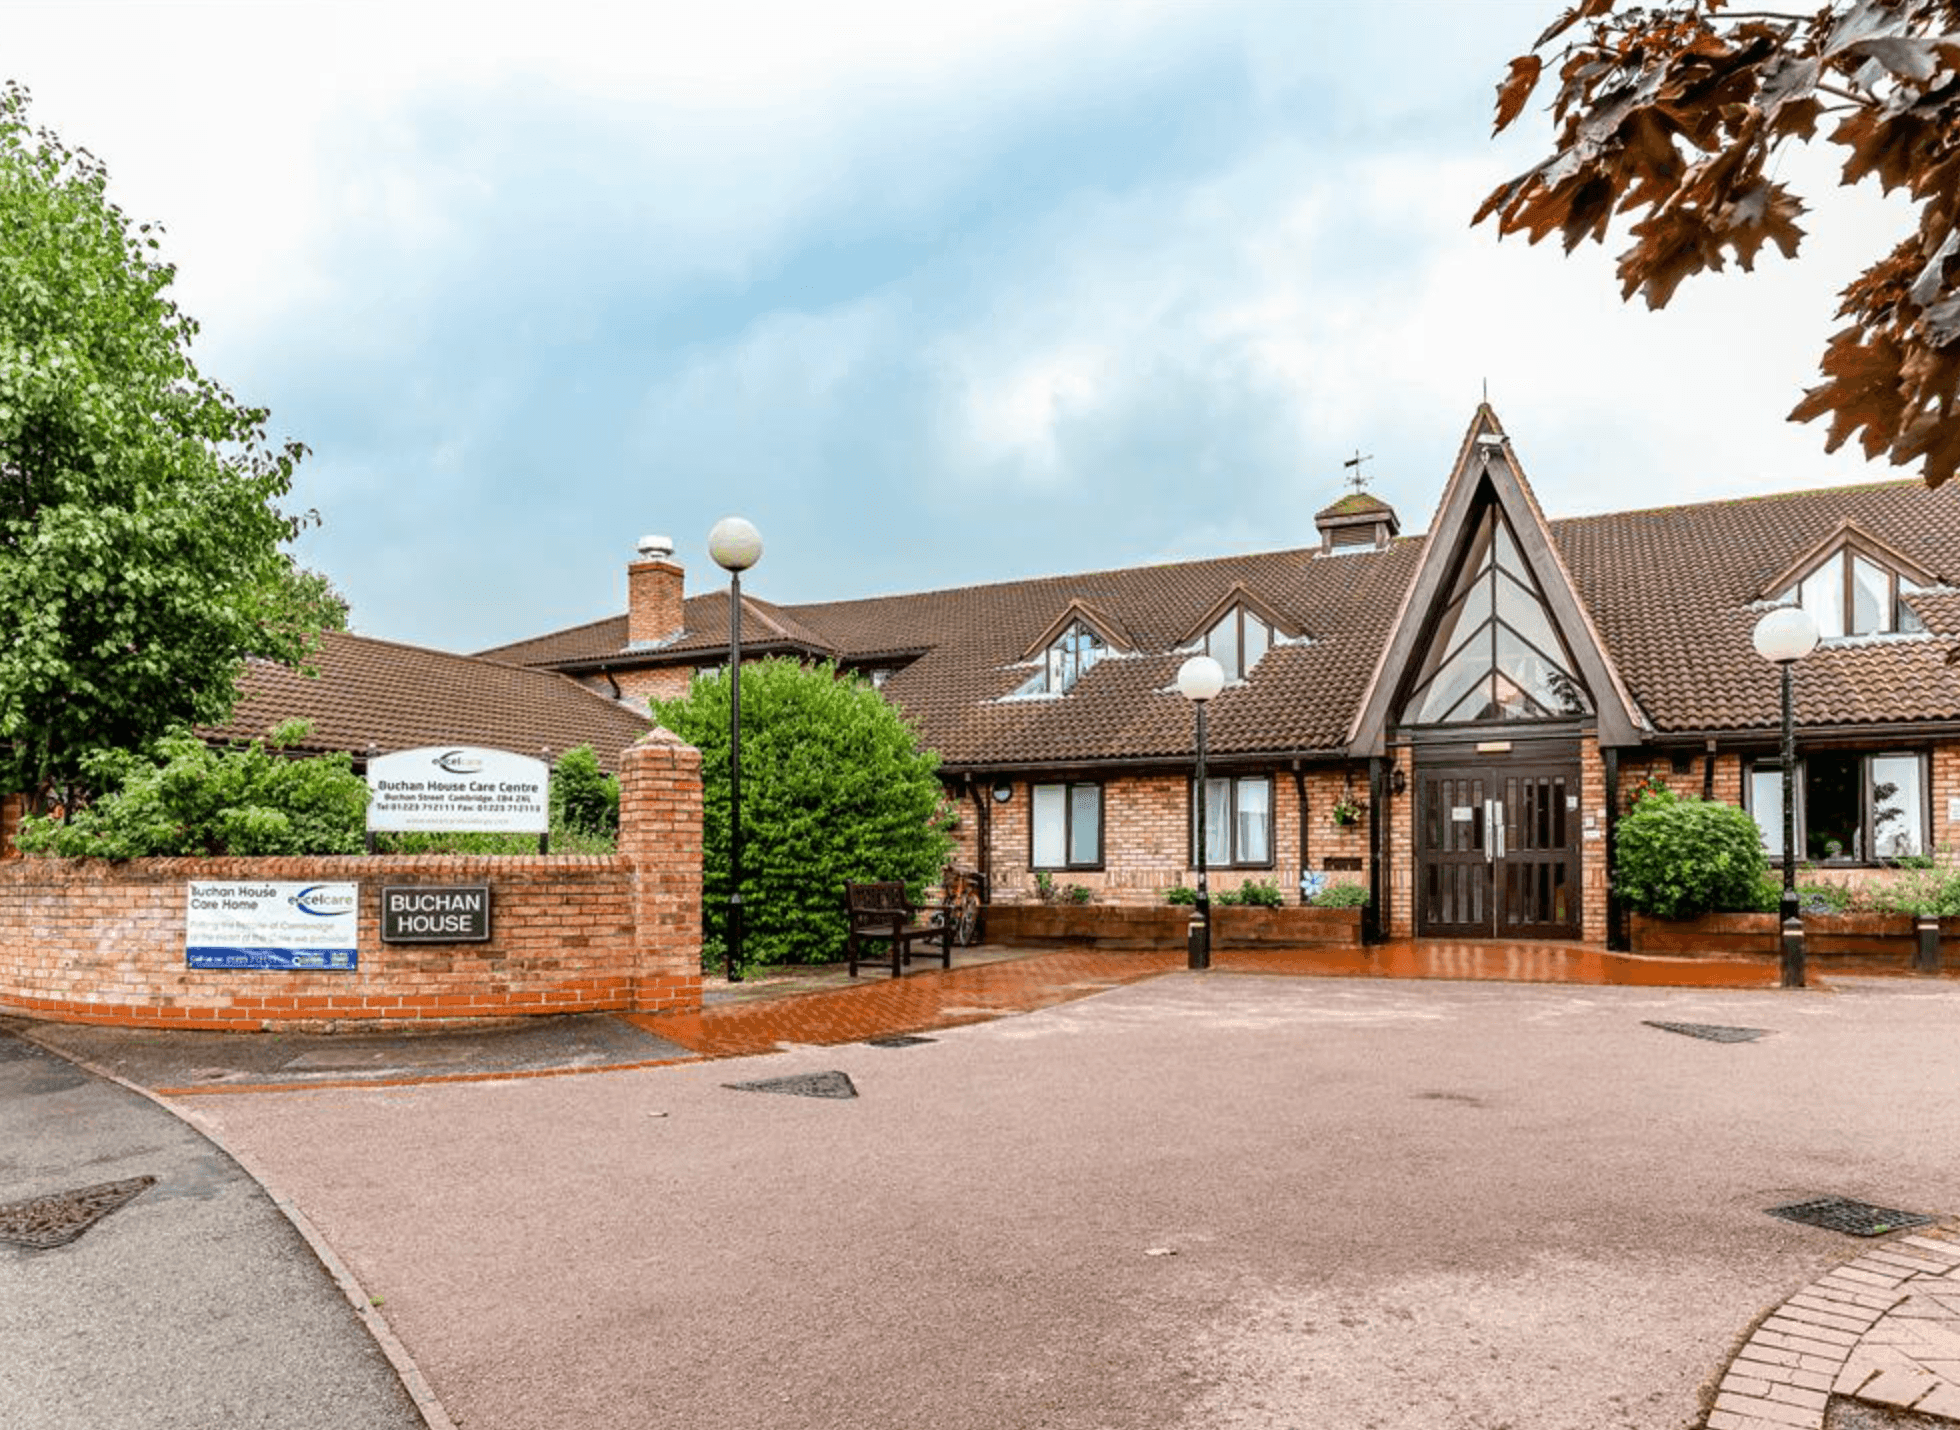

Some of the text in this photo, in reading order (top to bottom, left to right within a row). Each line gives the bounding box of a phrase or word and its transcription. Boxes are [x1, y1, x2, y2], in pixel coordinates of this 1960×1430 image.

[378, 780, 538, 793] Buchan House Care Centre
[191, 886, 277, 898] Buchan House
[191, 898, 258, 910] Care Home
[391, 895, 480, 912] BUCHAN
[398, 915, 473, 932] HOUSE
